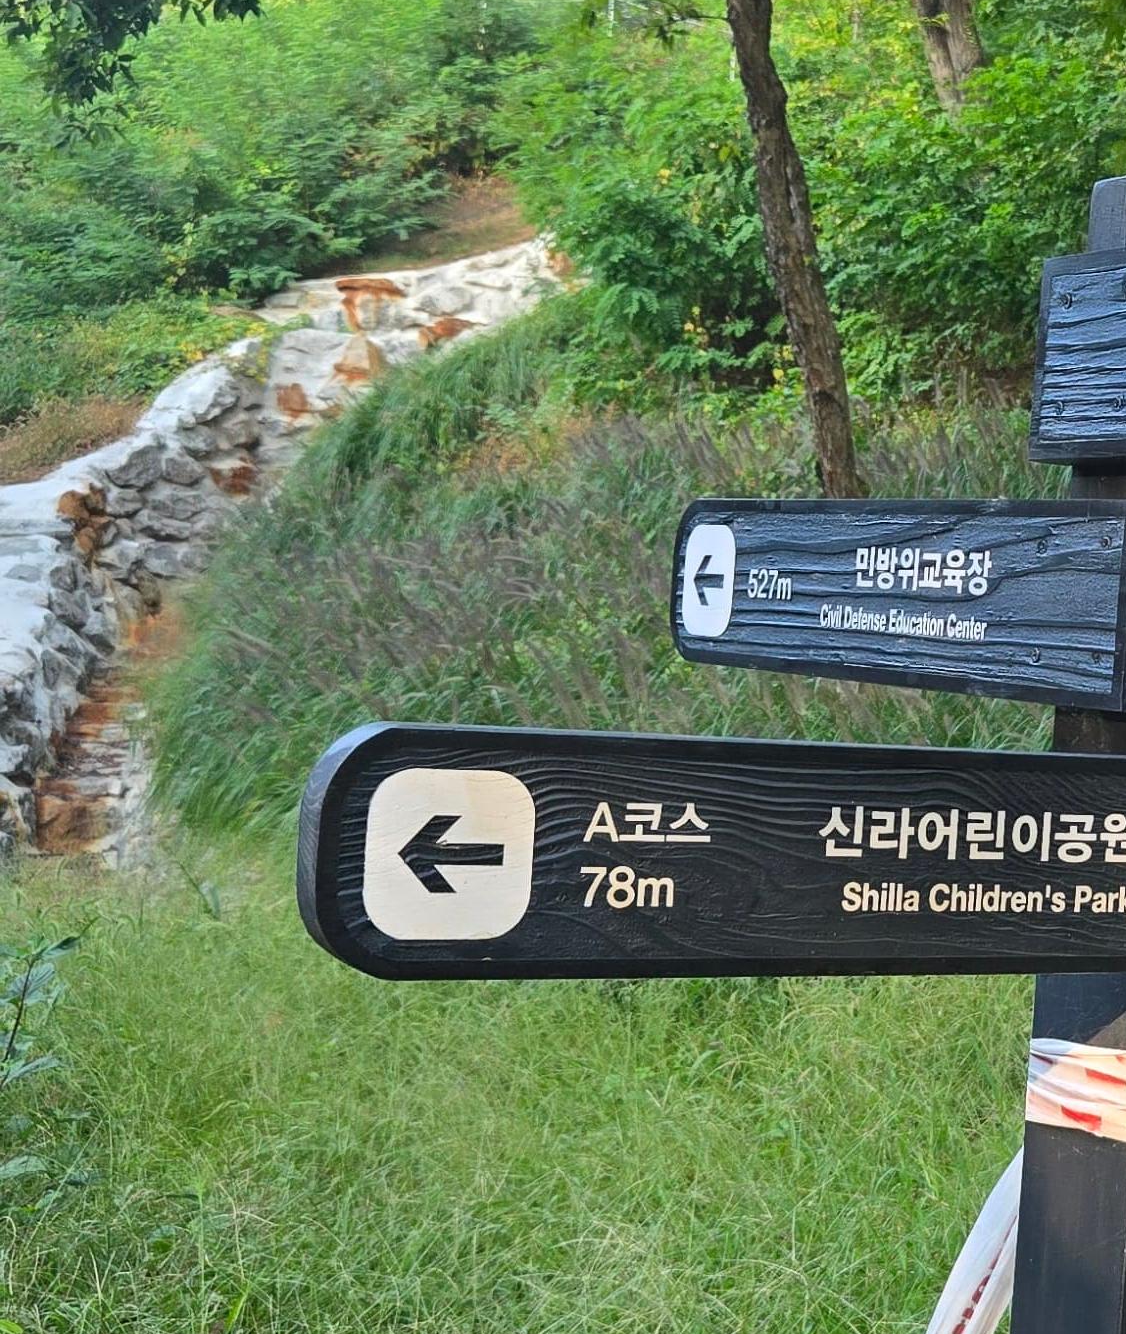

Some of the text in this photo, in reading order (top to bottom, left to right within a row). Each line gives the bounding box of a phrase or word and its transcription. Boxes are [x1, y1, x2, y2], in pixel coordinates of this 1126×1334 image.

[747, 569, 792, 601] 527m
[855, 546, 993, 597] 민방위교육장
[820, 604, 988, 640] Civil Defense Education Center
[583, 801, 711, 843] A코스
[580, 866, 674, 909] 78m
[841, 881, 919, 913] Shilla
[928, 883, 1066, 914] Children's
